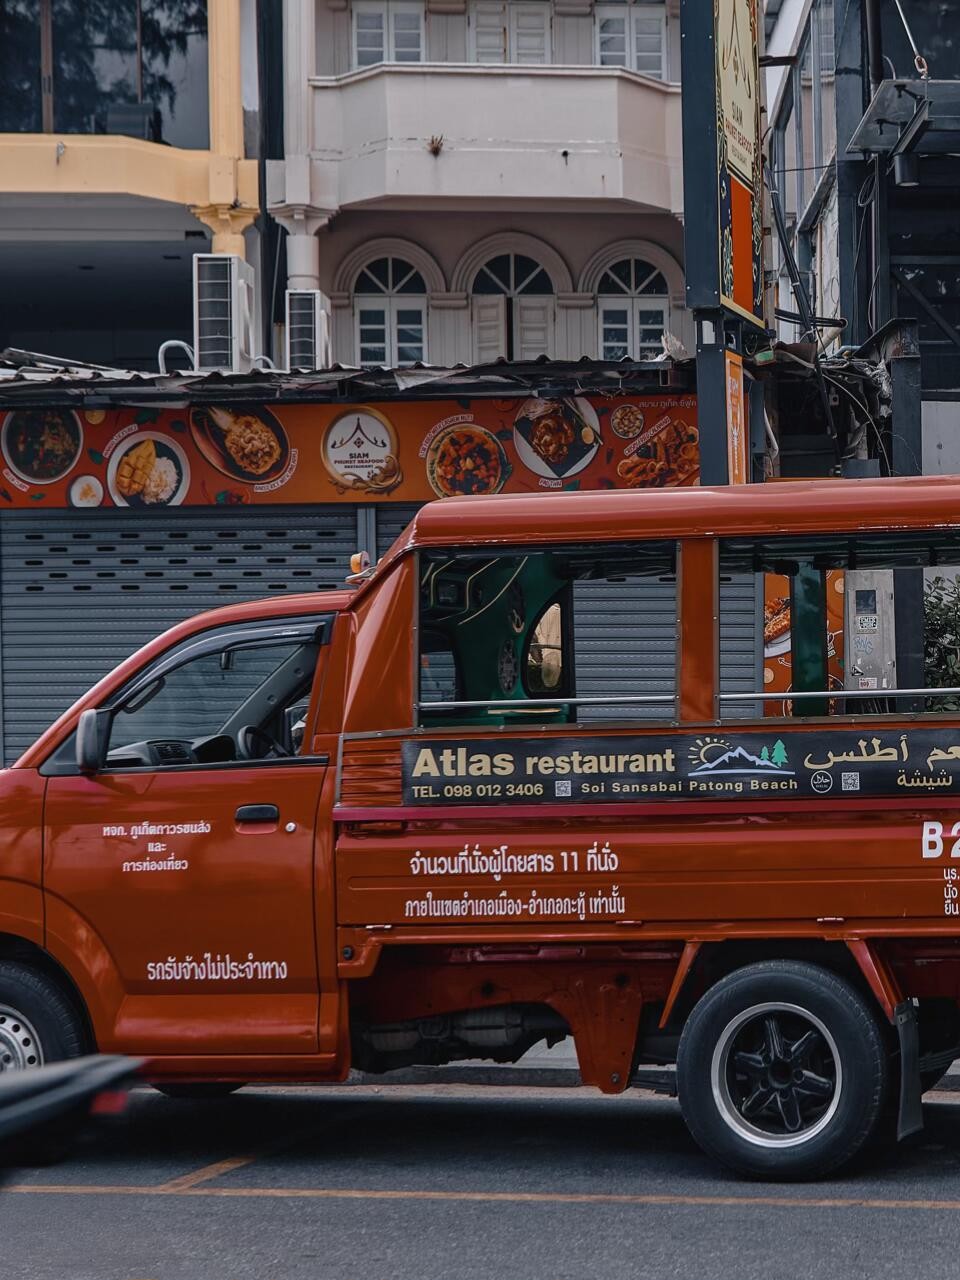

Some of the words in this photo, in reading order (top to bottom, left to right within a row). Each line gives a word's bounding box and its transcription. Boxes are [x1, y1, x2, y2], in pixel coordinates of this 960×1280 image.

[731, 102, 743, 130] SIAM
[348, 452, 369, 460] SIAM
[411, 747, 514, 777] Atlas
[526, 749, 675, 775] restaurant
[803, 734, 909, 769] أطلس
[581, 782, 605, 793] Soi
[612, 780, 682, 793] Sansabai
[689, 780, 743, 792] Patong
[750, 779, 798, 791] Beach
[897, 768, 953, 790] شيشة
[412, 785, 440, 798] TEL.
[444, 784, 472, 797] 098
[476, 784, 502, 797] 012
[505, 783, 544, 796] 3406
[148, 842, 167, 852] และ
[922, 821, 944, 859] B
[122, 853, 188, 872] การท่องเที่ยว
[410, 843, 554, 882] จำนวนที่นั่งผู้โดยสาร
[560, 851, 579, 871] 11
[586, 841, 619, 872] ที่นั่ง
[589, 884, 625, 915] เท่านั้น
[944, 880, 958, 899] นั่ง
[944, 898, 960, 915] ยืน
[147, 952, 288, 980] รถรับจ้างไม่ประจำทาง
